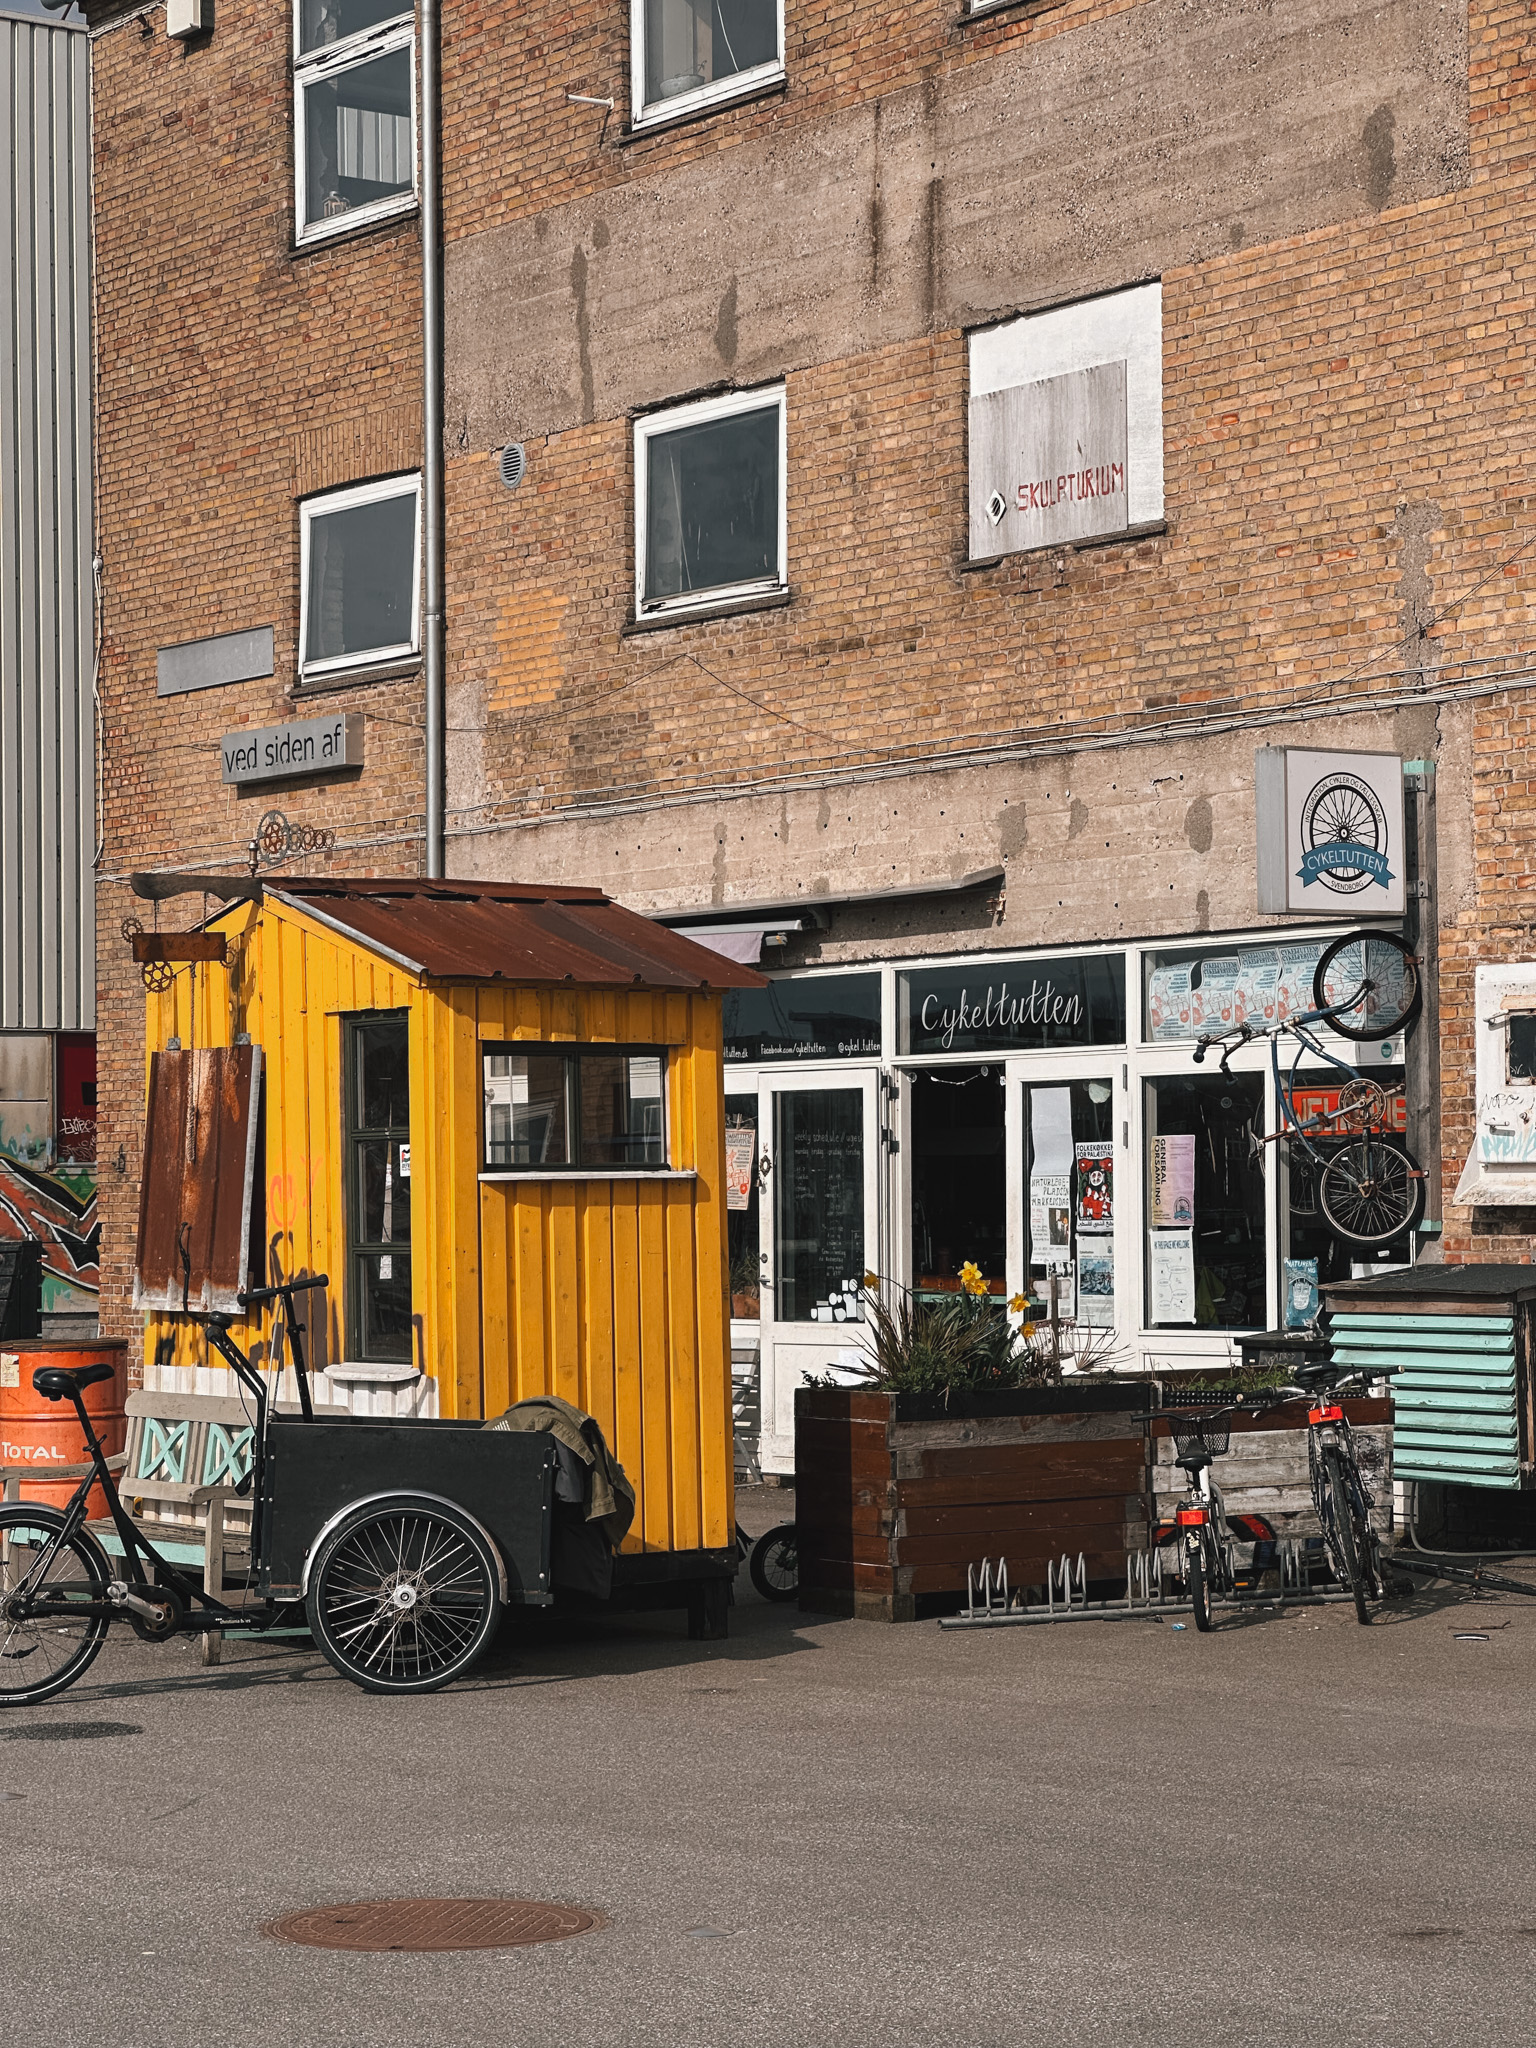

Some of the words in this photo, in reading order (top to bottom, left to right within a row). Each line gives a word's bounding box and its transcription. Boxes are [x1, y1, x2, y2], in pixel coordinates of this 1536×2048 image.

[1018, 463, 1124, 511] SKULPTURIUM
[225, 738, 257, 773] ved
[265, 732, 315, 767] siden
[322, 723, 342, 758] af
[1329, 776, 1350, 786] CYKLER
[1350, 779, 1360, 788] OG
[1359, 784, 1382, 824] FÆLLESSKAB
[1307, 849, 1384, 873] CYKELTUTTEN
[1331, 880, 1364, 891] SVENDBORG
[921, 980, 1084, 1049] Cykeltutten
[2, 1441, 65, 1459] TOTAL
